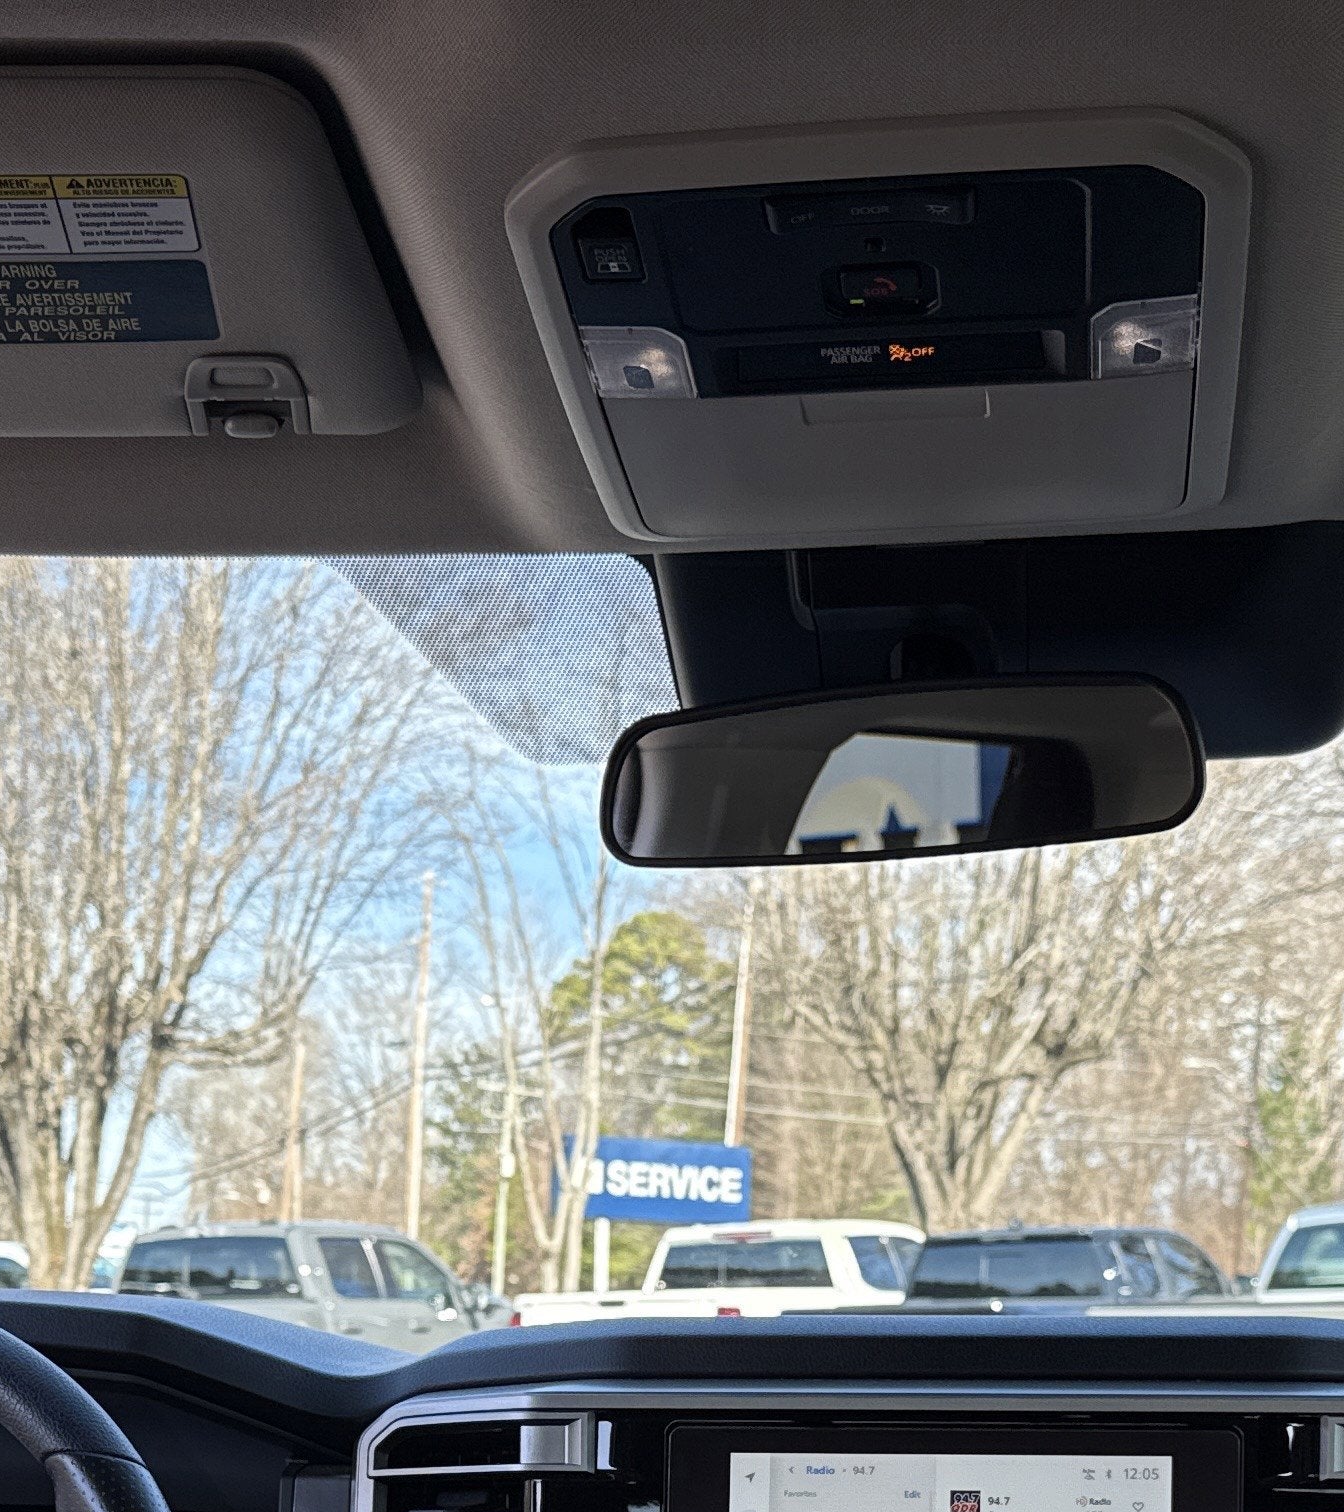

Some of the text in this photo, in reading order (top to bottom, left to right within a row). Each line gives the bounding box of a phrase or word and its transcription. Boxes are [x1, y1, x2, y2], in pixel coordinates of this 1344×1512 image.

[25, 280, 80, 290] OVER
[16, 292, 134, 306] AVERTISSEMENT
[4, 306, 125, 316] PARESOLEIL
[5, 319, 27, 332] LA
[30, 319, 78, 332] BOLSA
[83, 318, 101, 331] DE
[108, 318, 141, 331] AIRE
[20, 332, 44, 342] AL
[57, 331, 116, 341] VISOR
[821, 345, 881, 357] PASSENGER
[831, 354, 873, 364] AIR BAG
[606, 1159, 744, 1204] SERVICE
[806, 1466, 875, 1475] Radio 94.7
[1122, 1468, 1159, 1480] 12:05
[904, 1490, 922, 1499] Edit
[987, 1497, 1010, 1505] 94.7
